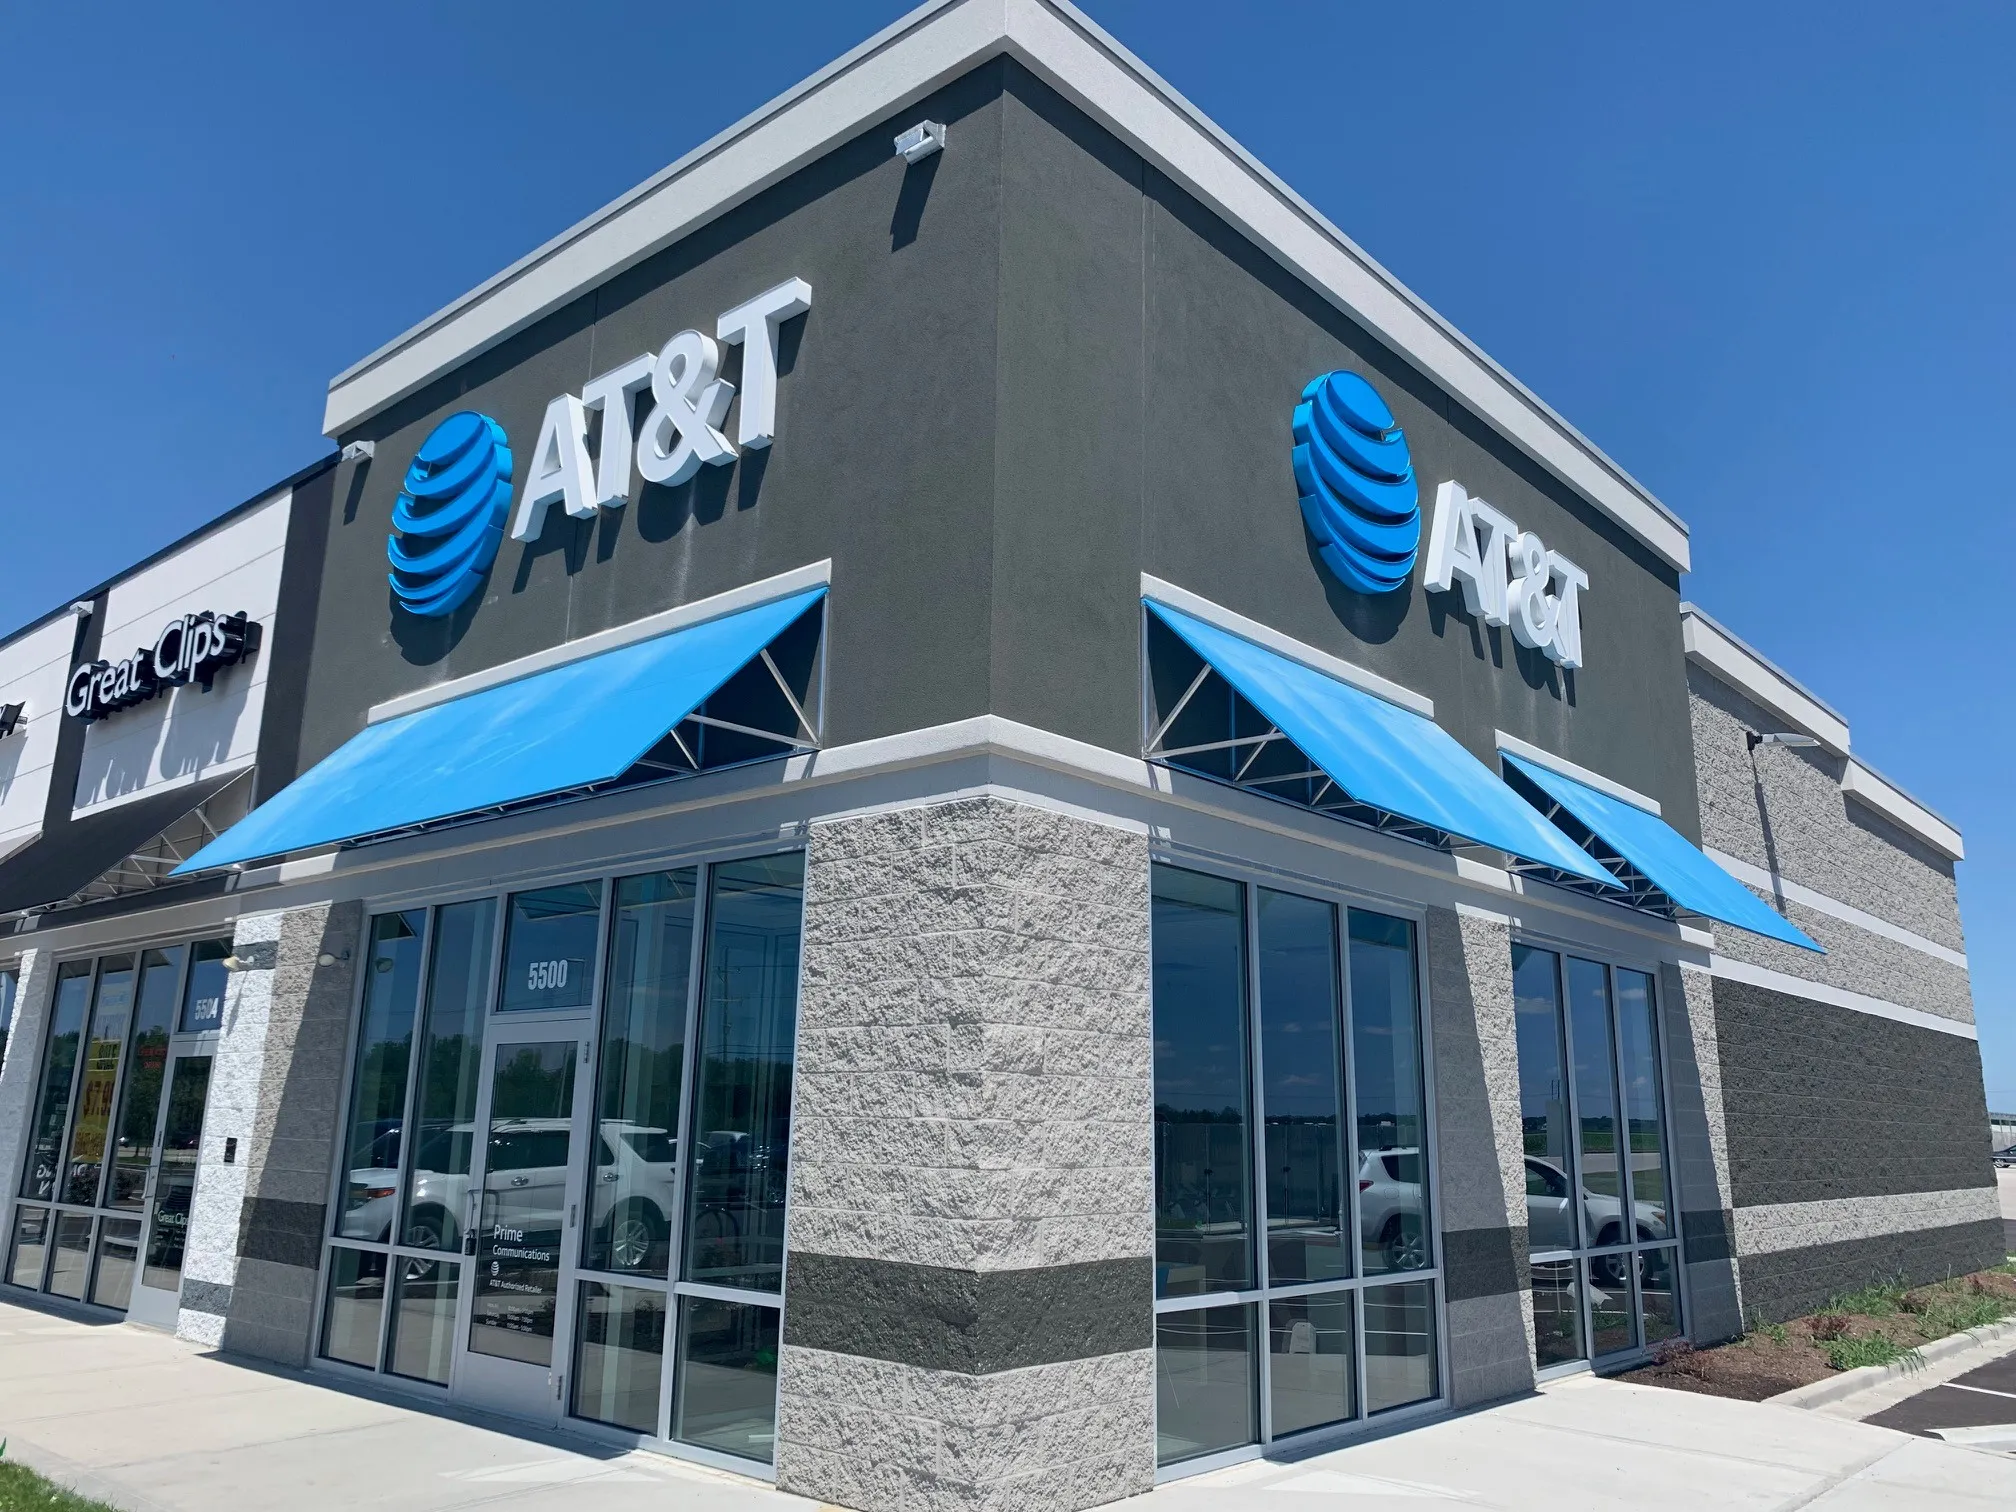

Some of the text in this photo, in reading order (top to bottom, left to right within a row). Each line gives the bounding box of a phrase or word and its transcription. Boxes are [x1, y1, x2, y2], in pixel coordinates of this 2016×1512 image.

[511, 277, 811, 542] AT&T
[1423, 479, 1589, 670] AT&T
[66, 611, 230, 717] Great Clips
[527, 959, 568, 991] 5500
[194, 997, 219, 1020] 5504
[493, 1224, 523, 1242] Prime
[492, 1244, 550, 1262] Communications
